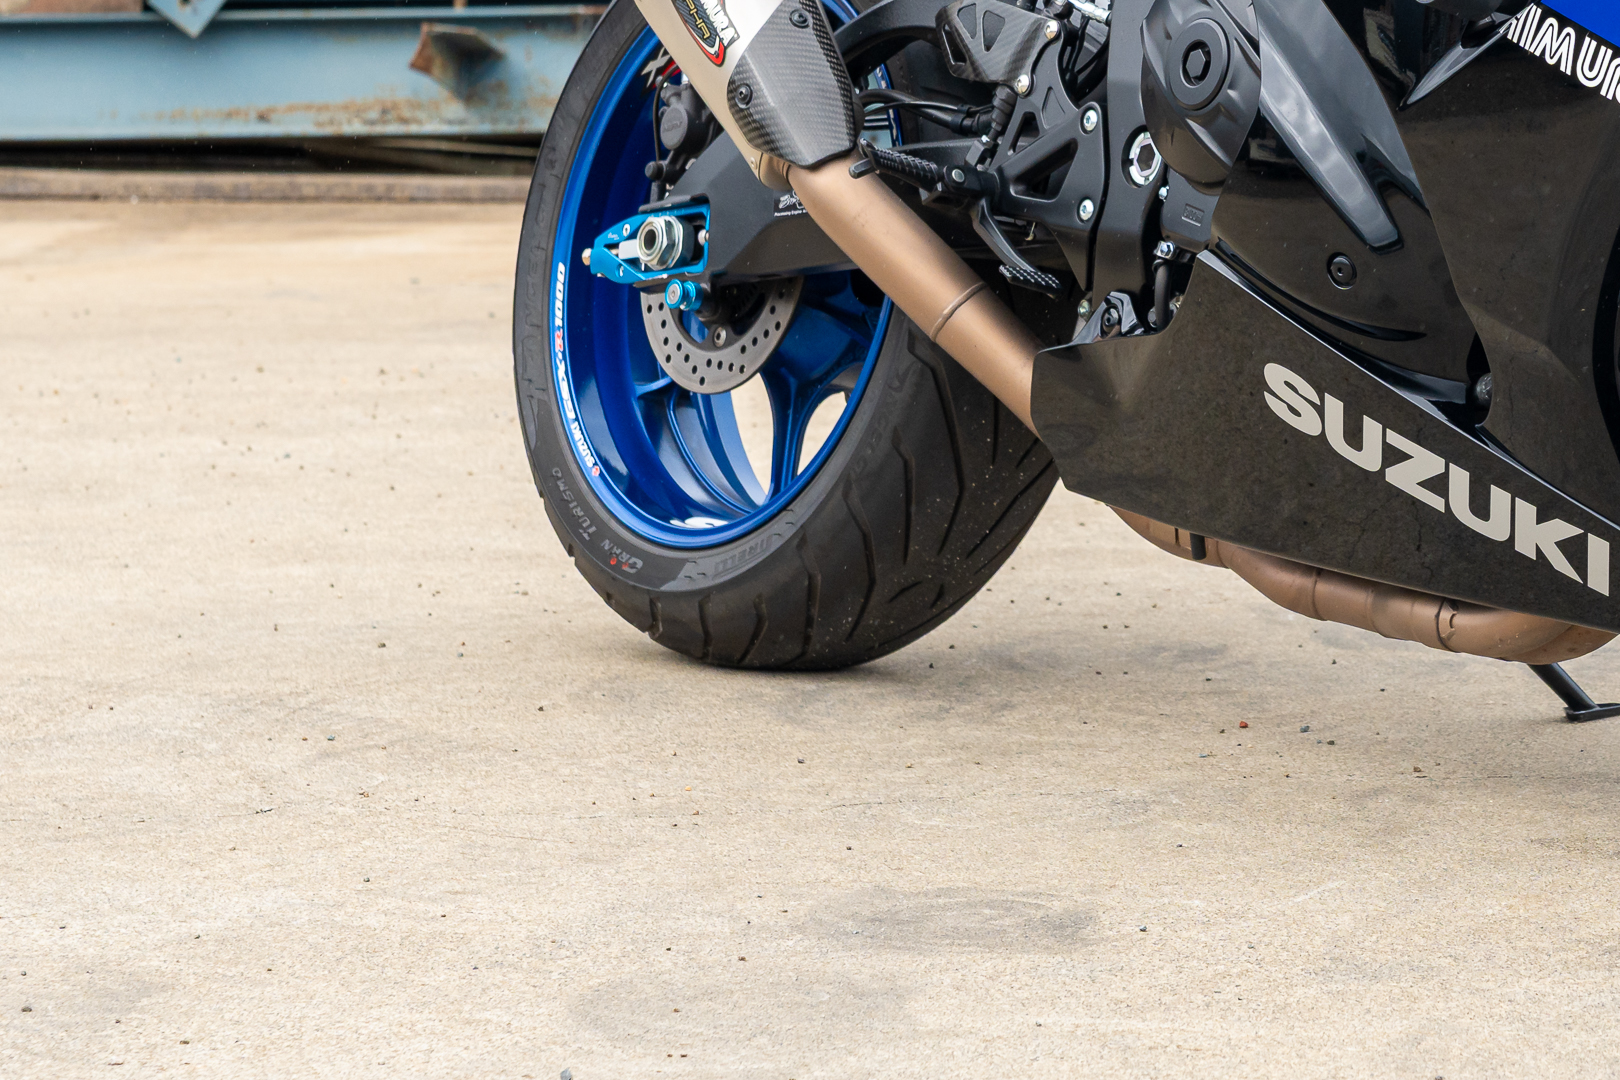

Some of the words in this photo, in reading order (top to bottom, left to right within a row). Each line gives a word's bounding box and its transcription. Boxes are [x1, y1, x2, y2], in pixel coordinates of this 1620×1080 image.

[571, 420, 596, 468] SUZUKI
[1263, 362, 1610, 597] SUZUKI
[552, 466, 597, 541] TURISMO
